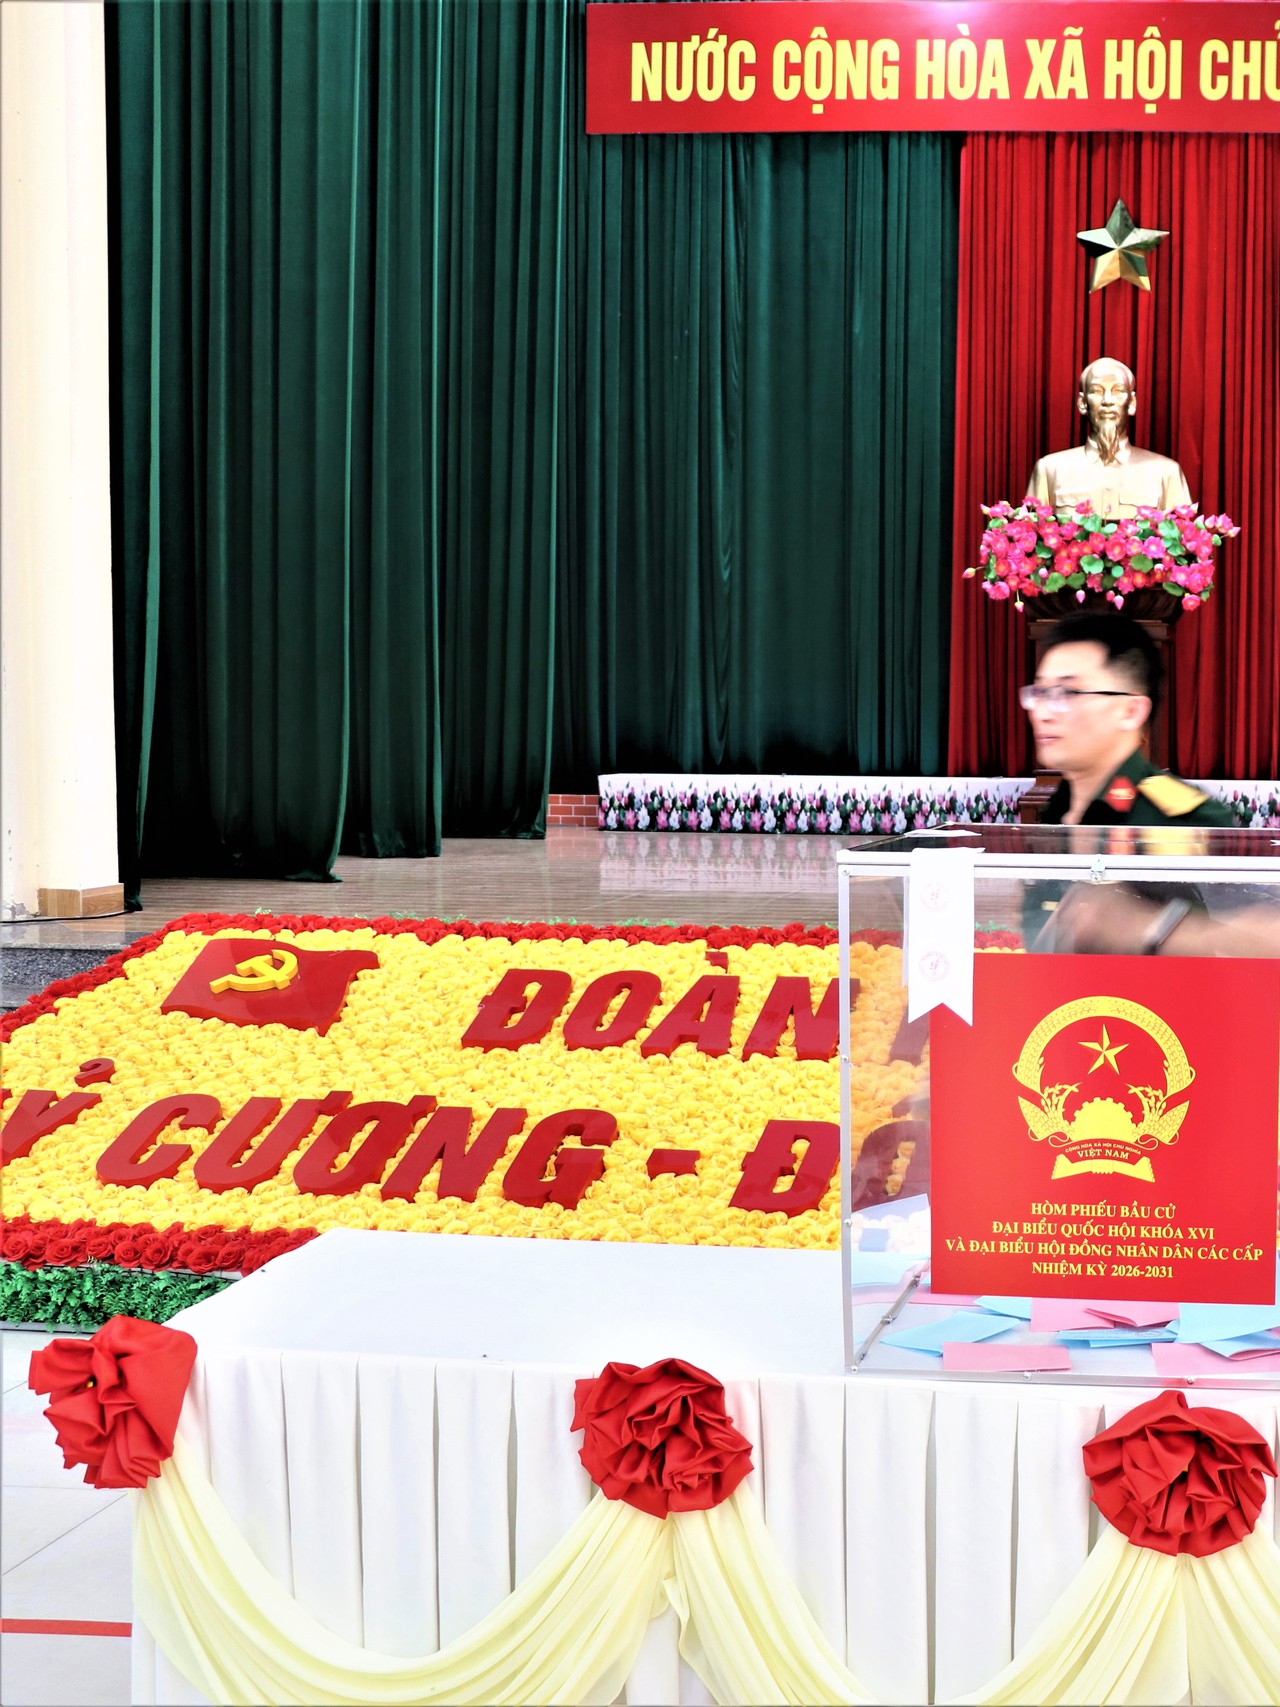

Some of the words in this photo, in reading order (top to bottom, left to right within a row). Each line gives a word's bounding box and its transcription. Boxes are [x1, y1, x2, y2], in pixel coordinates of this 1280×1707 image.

[630, 27, 757, 102] NƯỚC
[772, 26, 900, 115] CỘNG
[914, 23, 1010, 101] HÒA
[1023, 26, 1089, 99] XÃ
[1103, 25, 1183, 114] HỘI
[461, 951, 860, 1062] ĐOÀN
[0, 1058, 116, 1167] Ỷ
[96, 1090, 619, 1209] CƯƠNG
[1077, 1148, 1102, 1158] VIỆT
[1105, 1149, 1130, 1159] NAM
[1031, 1201, 1067, 1216] HÒM
[1070, 1200, 1116, 1218] PHIẾU
[1120, 1200, 1151, 1219] BẦU
[1154, 1203, 1177, 1220] CỬ
[991, 1220, 1019, 1236] ĐẠI
[1022, 1217, 1057, 1236] BIỂU
[1060, 1219, 1105, 1239] QUỐC
[1107, 1223, 1136, 1240] HỘI
[1139, 1224, 1184, 1239] KHÓA
[1187, 1227, 1214, 1240] XVI
[945, 1238, 966, 1252] VÀ
[968, 1239, 996, 1255] ĐẠI
[999, 1236, 1034, 1255] BIỂU
[1037, 1241, 1066, 1257] HỘI
[1068, 1238, 1112, 1257] ĐỒNG
[1116, 1242, 1159, 1258] NHÂN
[1162, 1243, 1194, 1259] DÂN
[1197, 1244, 1229, 1260] CÁC
[1232, 1244, 1264, 1261] CẤP
[1032, 1260, 1083, 1277] NHIỆM
[1086, 1261, 1107, 1276] KỲ
[1111, 1264, 1173, 1278] 2026-2031
